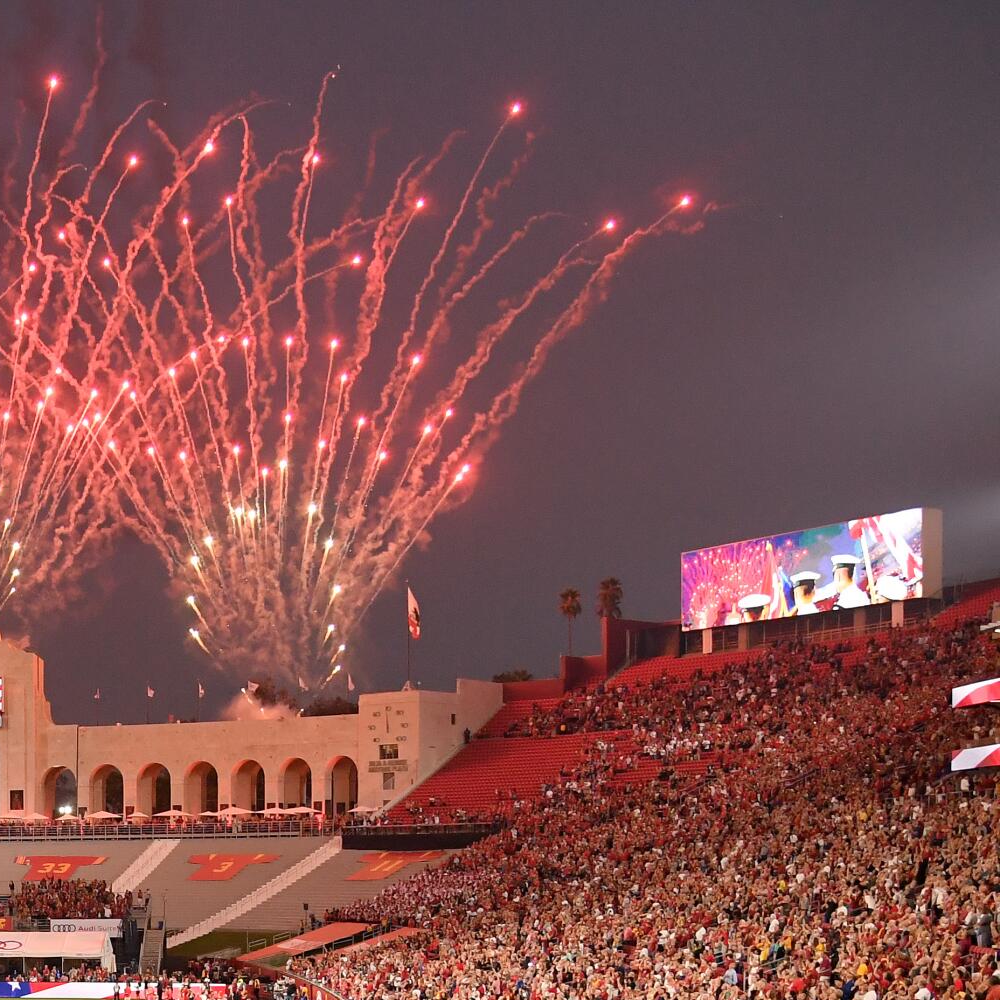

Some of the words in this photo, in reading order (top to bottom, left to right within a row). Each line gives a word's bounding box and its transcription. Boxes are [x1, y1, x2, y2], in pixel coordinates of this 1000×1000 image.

[37, 862, 70, 873] 33
[212, 861, 233, 872] 3
[370, 860, 401, 872] 11
